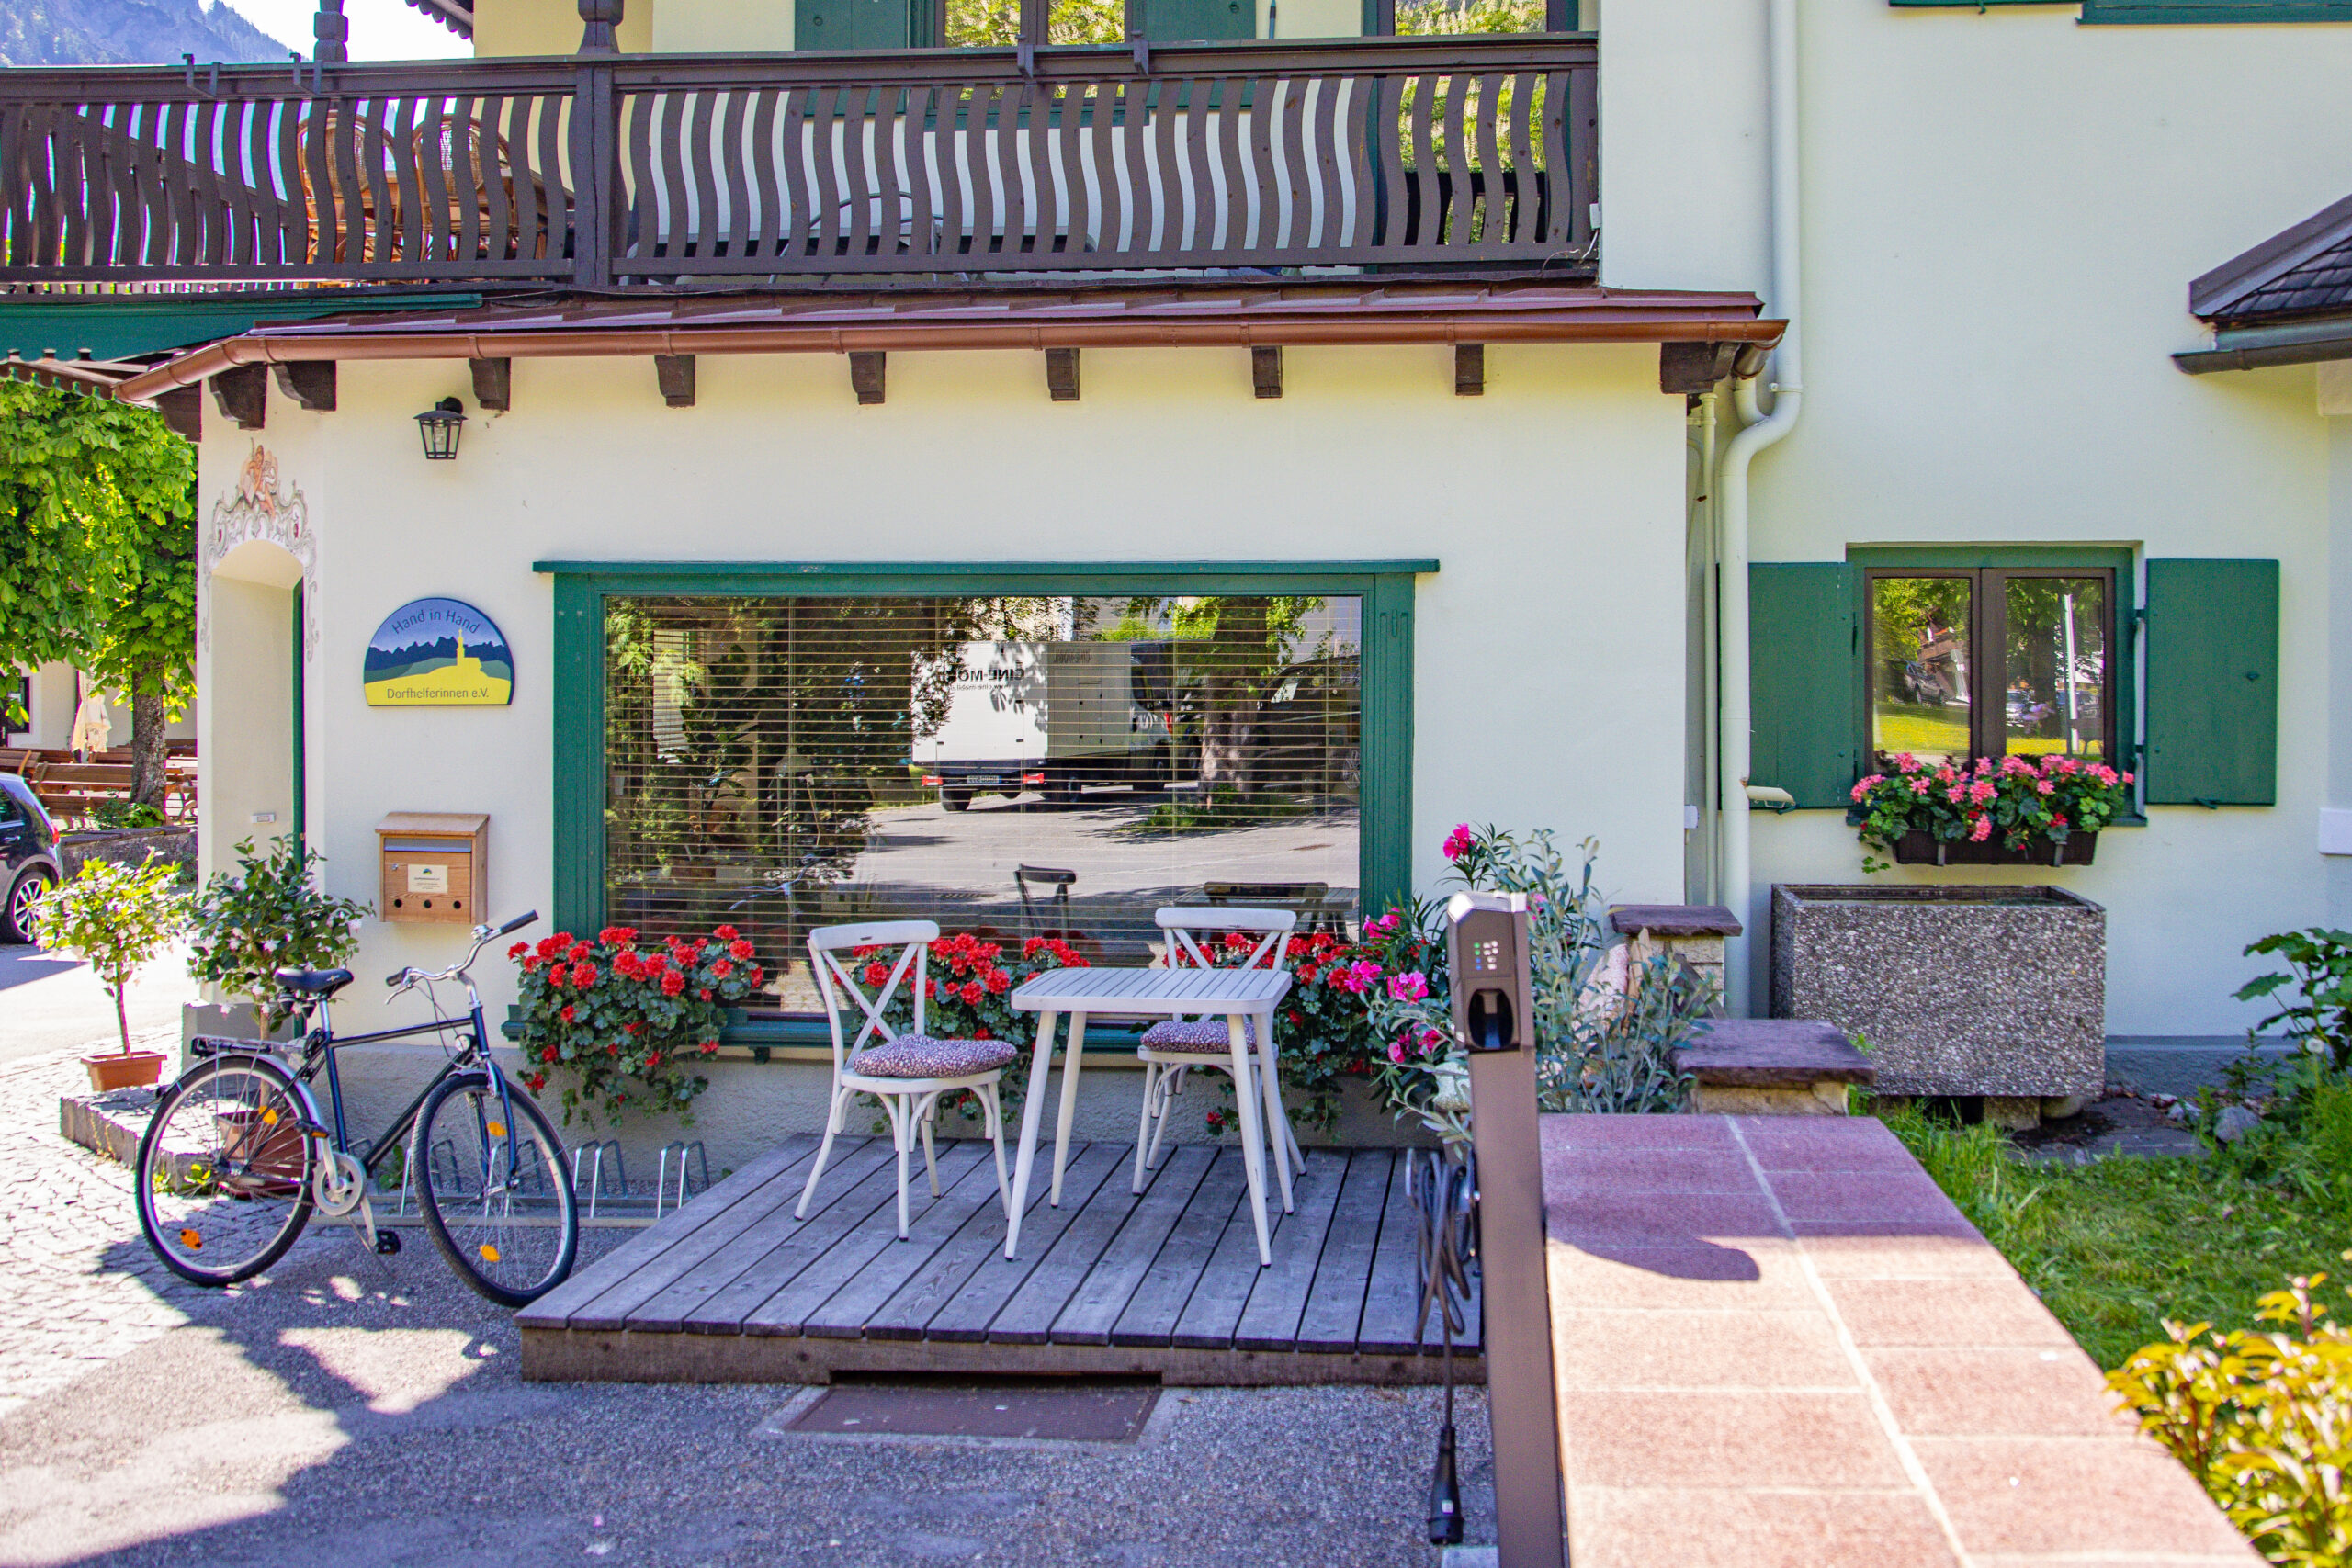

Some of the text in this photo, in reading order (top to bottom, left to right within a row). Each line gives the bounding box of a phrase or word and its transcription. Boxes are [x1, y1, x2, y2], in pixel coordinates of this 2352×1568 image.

[391, 609, 481, 634] Hand in Hand
[387, 687, 489, 699] Dorfhelferinnen e.V.
